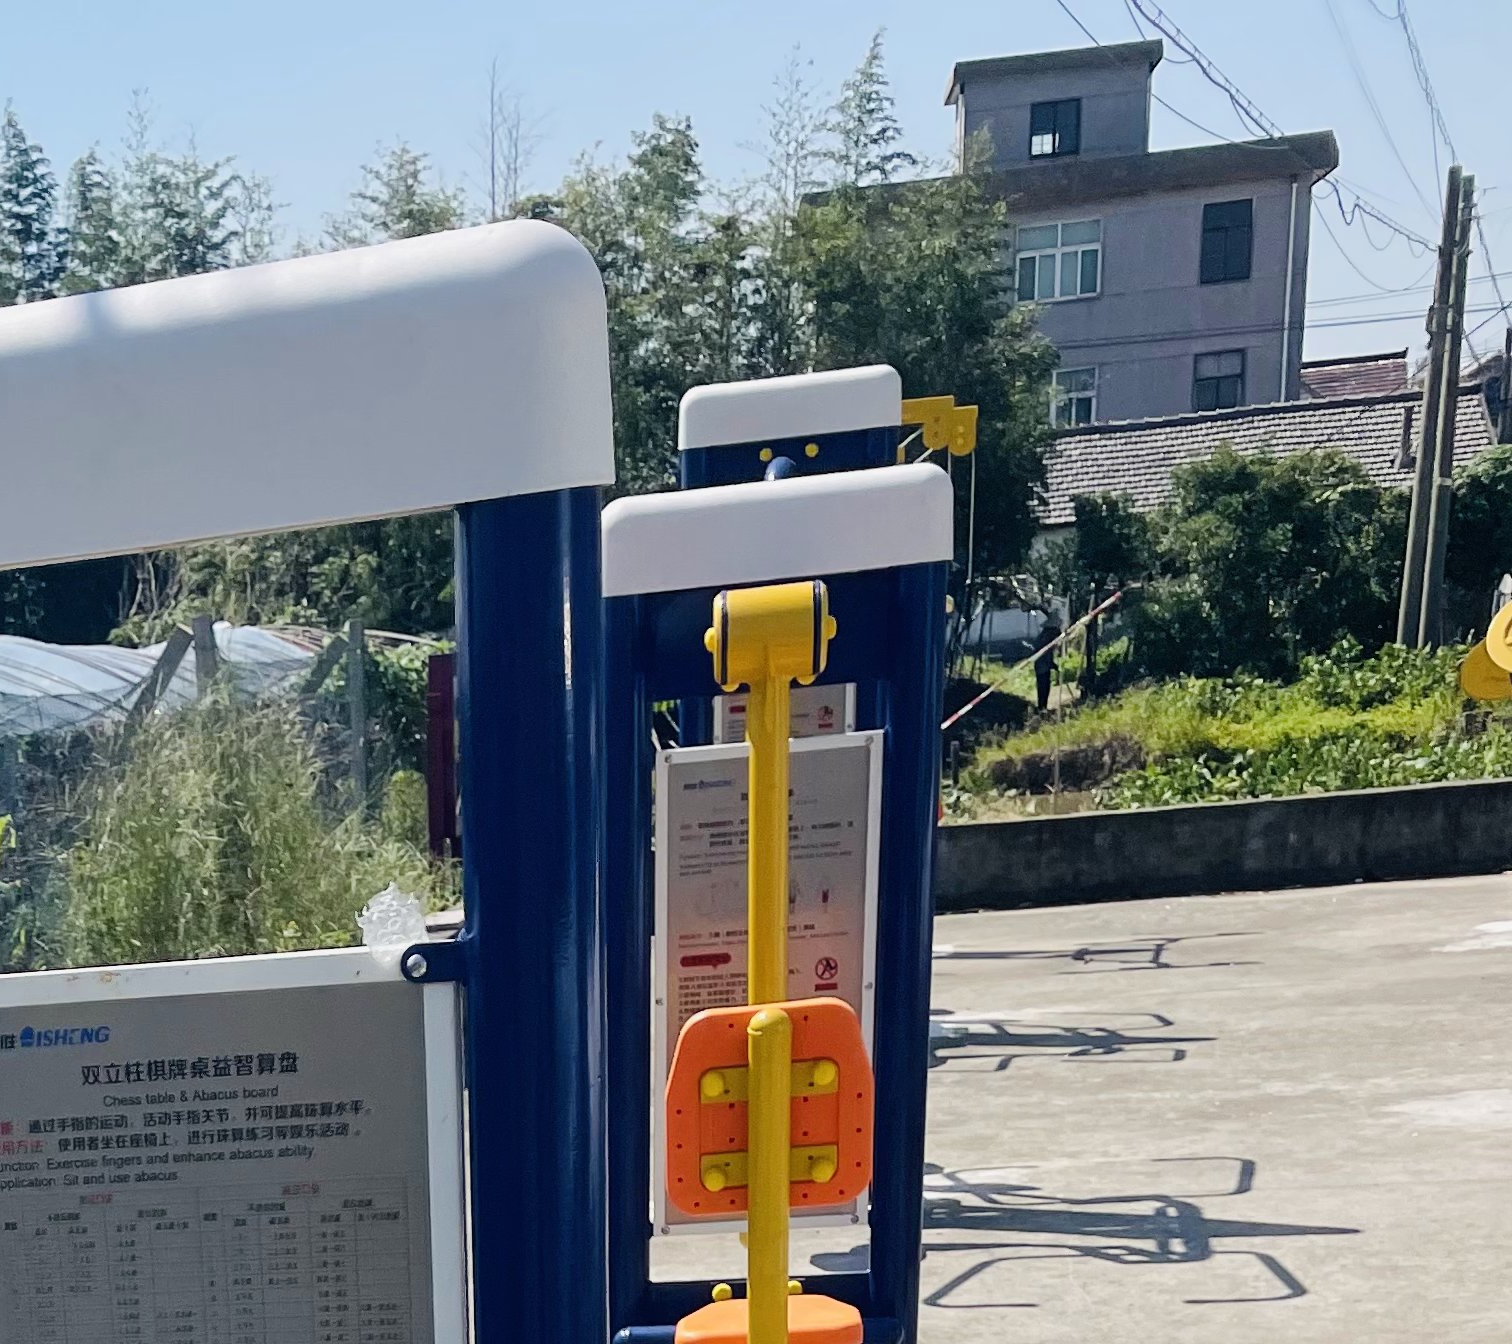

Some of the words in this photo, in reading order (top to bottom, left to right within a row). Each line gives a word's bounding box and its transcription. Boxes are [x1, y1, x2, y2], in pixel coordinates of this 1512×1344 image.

[81, 1051, 299, 1087] 双立柱棋牌桌益智算盘
[103, 1093, 142, 1107] Chess
[146, 1091, 176, 1104] table
[179, 1090, 189, 1102] &
[193, 1087, 239, 1102] Abacus
[242, 1085, 279, 1099] board
[47, 1157, 98, 1170] Exercise
[101, 1155, 143, 1169] fingers
[145, 1152, 169, 1165] and
[173, 1150, 226, 1163] enhance
[229, 1147, 274, 1160] abacus
[277, 1144, 316, 1161] ability
[82, 1173, 105, 1185] and
[108, 1172, 131, 1184] use
[135, 1170, 179, 1182] abacus
